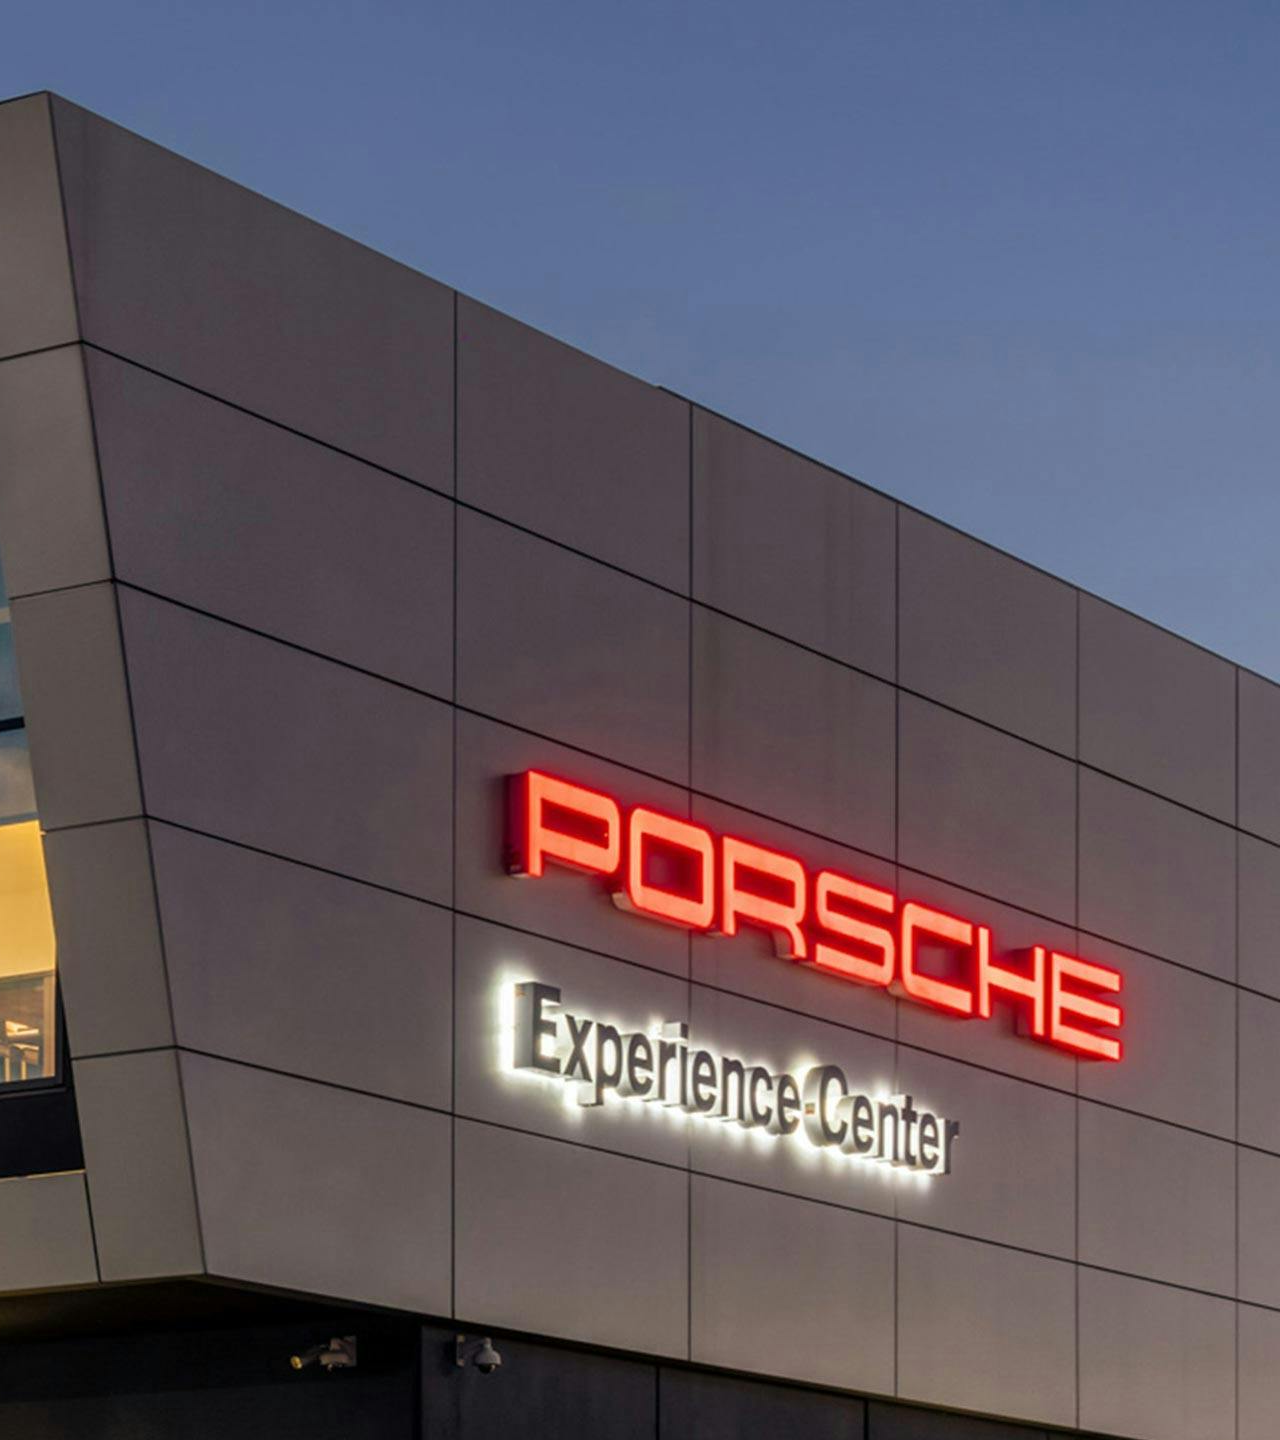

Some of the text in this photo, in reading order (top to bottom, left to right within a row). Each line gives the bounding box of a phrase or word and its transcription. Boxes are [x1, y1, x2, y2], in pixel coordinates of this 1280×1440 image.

[510, 769, 1122, 1061] PORSCHE
[514, 981, 959, 1176] Experience Center
